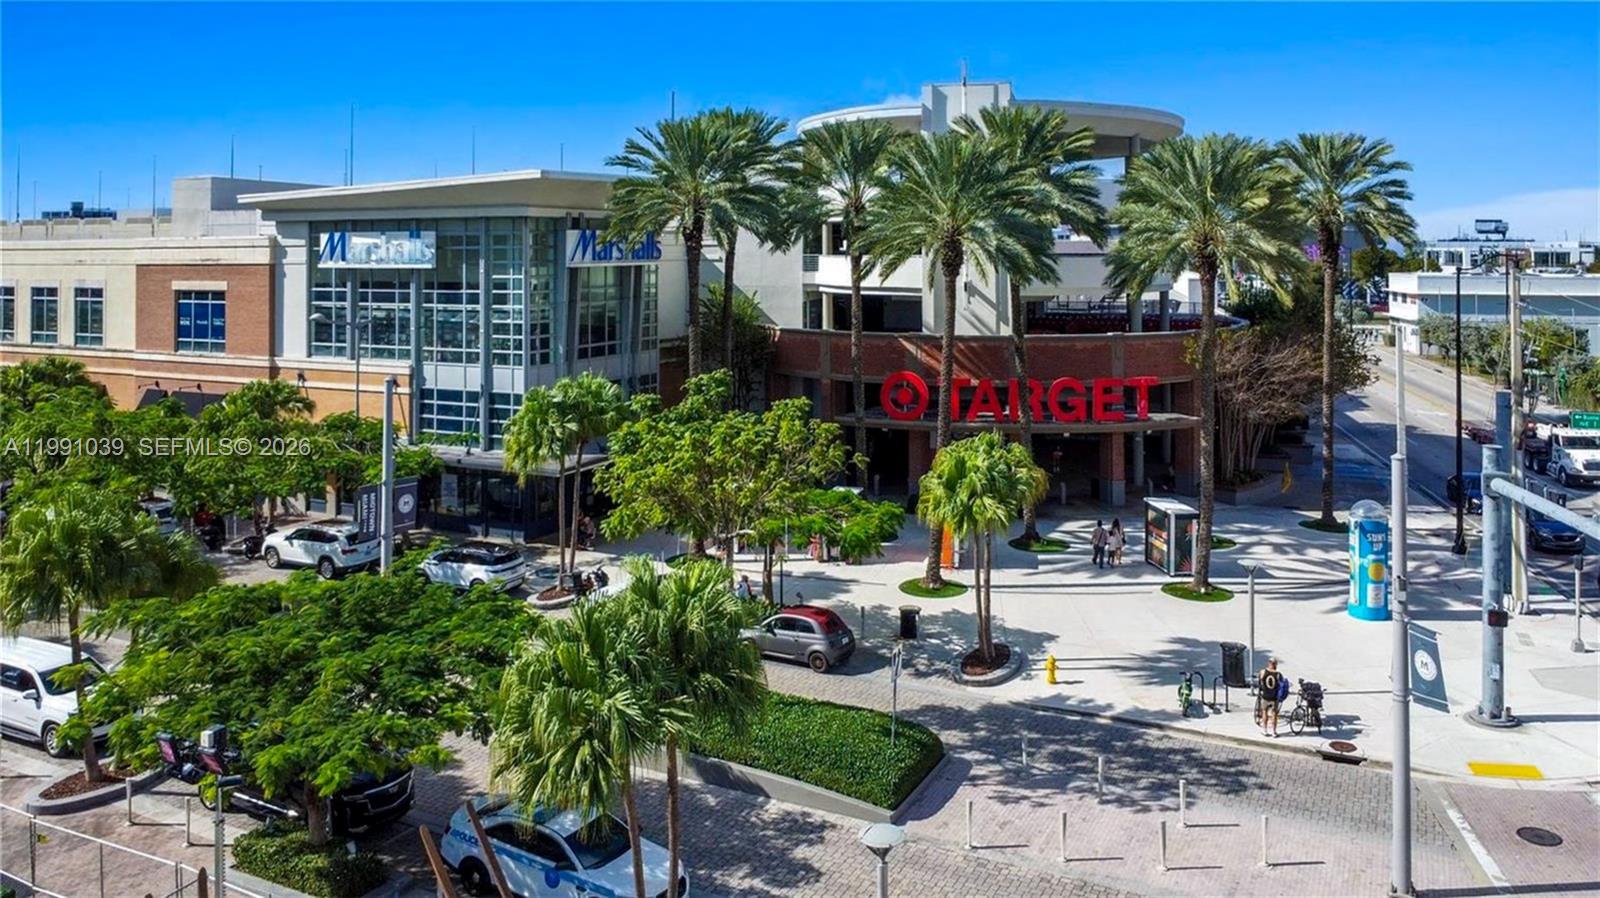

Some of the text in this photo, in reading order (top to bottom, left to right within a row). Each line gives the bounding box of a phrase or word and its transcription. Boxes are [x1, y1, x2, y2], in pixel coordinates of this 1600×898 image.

[318, 231, 434, 264] Marshalls
[937, 376, 1158, 423] TARGET
[453, 829, 480, 847] POLICE
